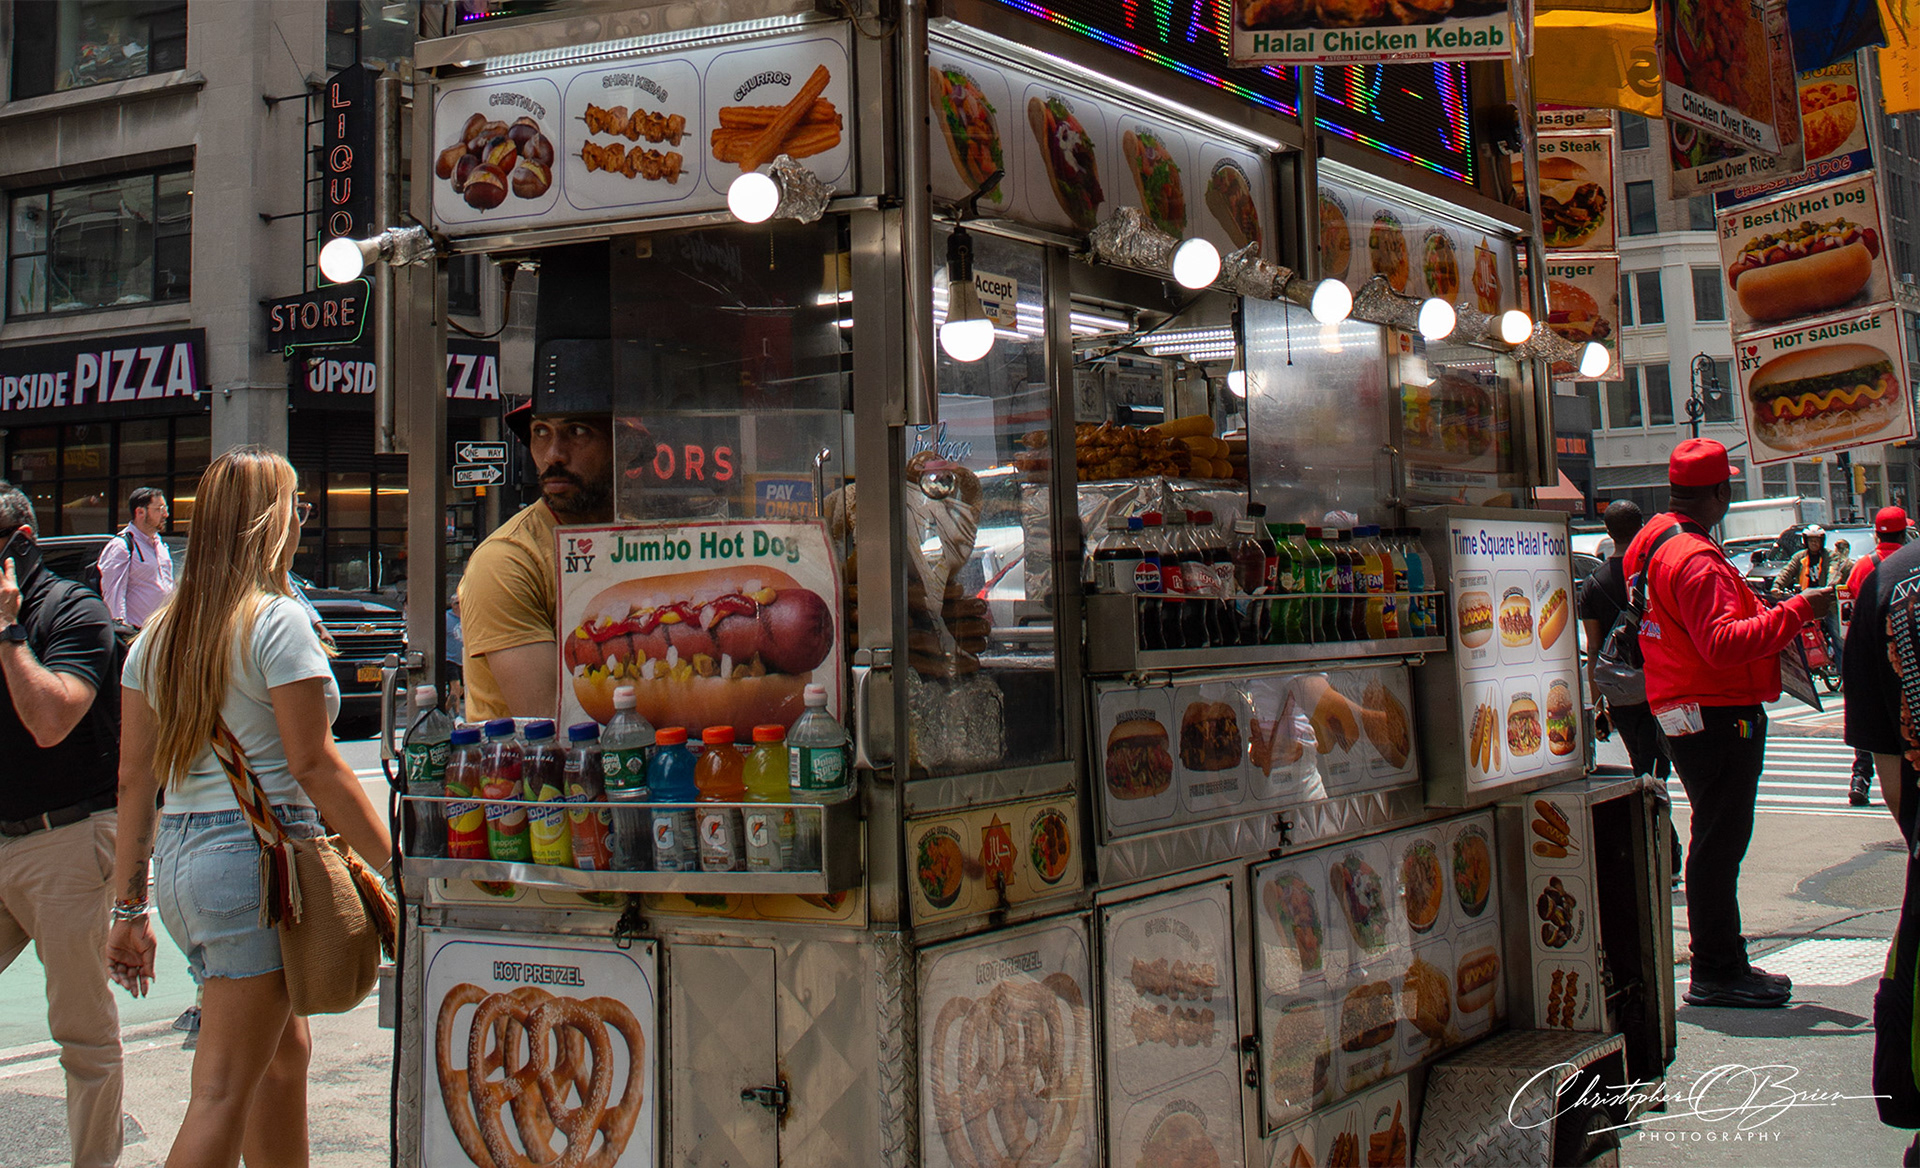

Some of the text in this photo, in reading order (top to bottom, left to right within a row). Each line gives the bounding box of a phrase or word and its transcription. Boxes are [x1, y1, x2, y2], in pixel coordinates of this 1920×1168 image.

[1253, 26, 1504, 53] Halal Chicken Kebab
[733, 70, 792, 103] CHURROS
[488, 92, 547, 120] CHESTNUTS
[1682, 92, 1762, 141] Chicken Over Rice
[329, 82, 353, 237] LIQUO
[1559, 140, 1601, 152] Steak
[1696, 155, 1776, 185] Lamb Over Rice
[1818, 155, 1852, 175] DOG
[1742, 210, 1779, 230] Best
[1799, 198, 1830, 216] Hot
[1832, 188, 1866, 207] Dog
[1723, 226, 1739, 240] NY
[975, 274, 1013, 300] Accept
[271, 298, 355, 332] STORE
[1773, 316, 1882, 350] HOT SAUSAGE
[0, 342, 194, 411] PSIDE PIZZA
[308, 359, 376, 394] UPSID
[1740, 356, 1762, 371] NY
[463, 448, 502, 458] ONE WAY
[458, 468, 497, 481] ONE WAY
[766, 484, 795, 500] PAY
[765, 501, 814, 517] OMATI
[610, 529, 800, 564] Jumbo Hot Dog
[1452, 527, 1567, 562] Time Square Halal Food
[564, 555, 596, 573] NY
[546, 817, 561, 827] tea
[493, 961, 585, 987] HOT PRETZEL
[976, 950, 1043, 985] HOT PRETZEL
